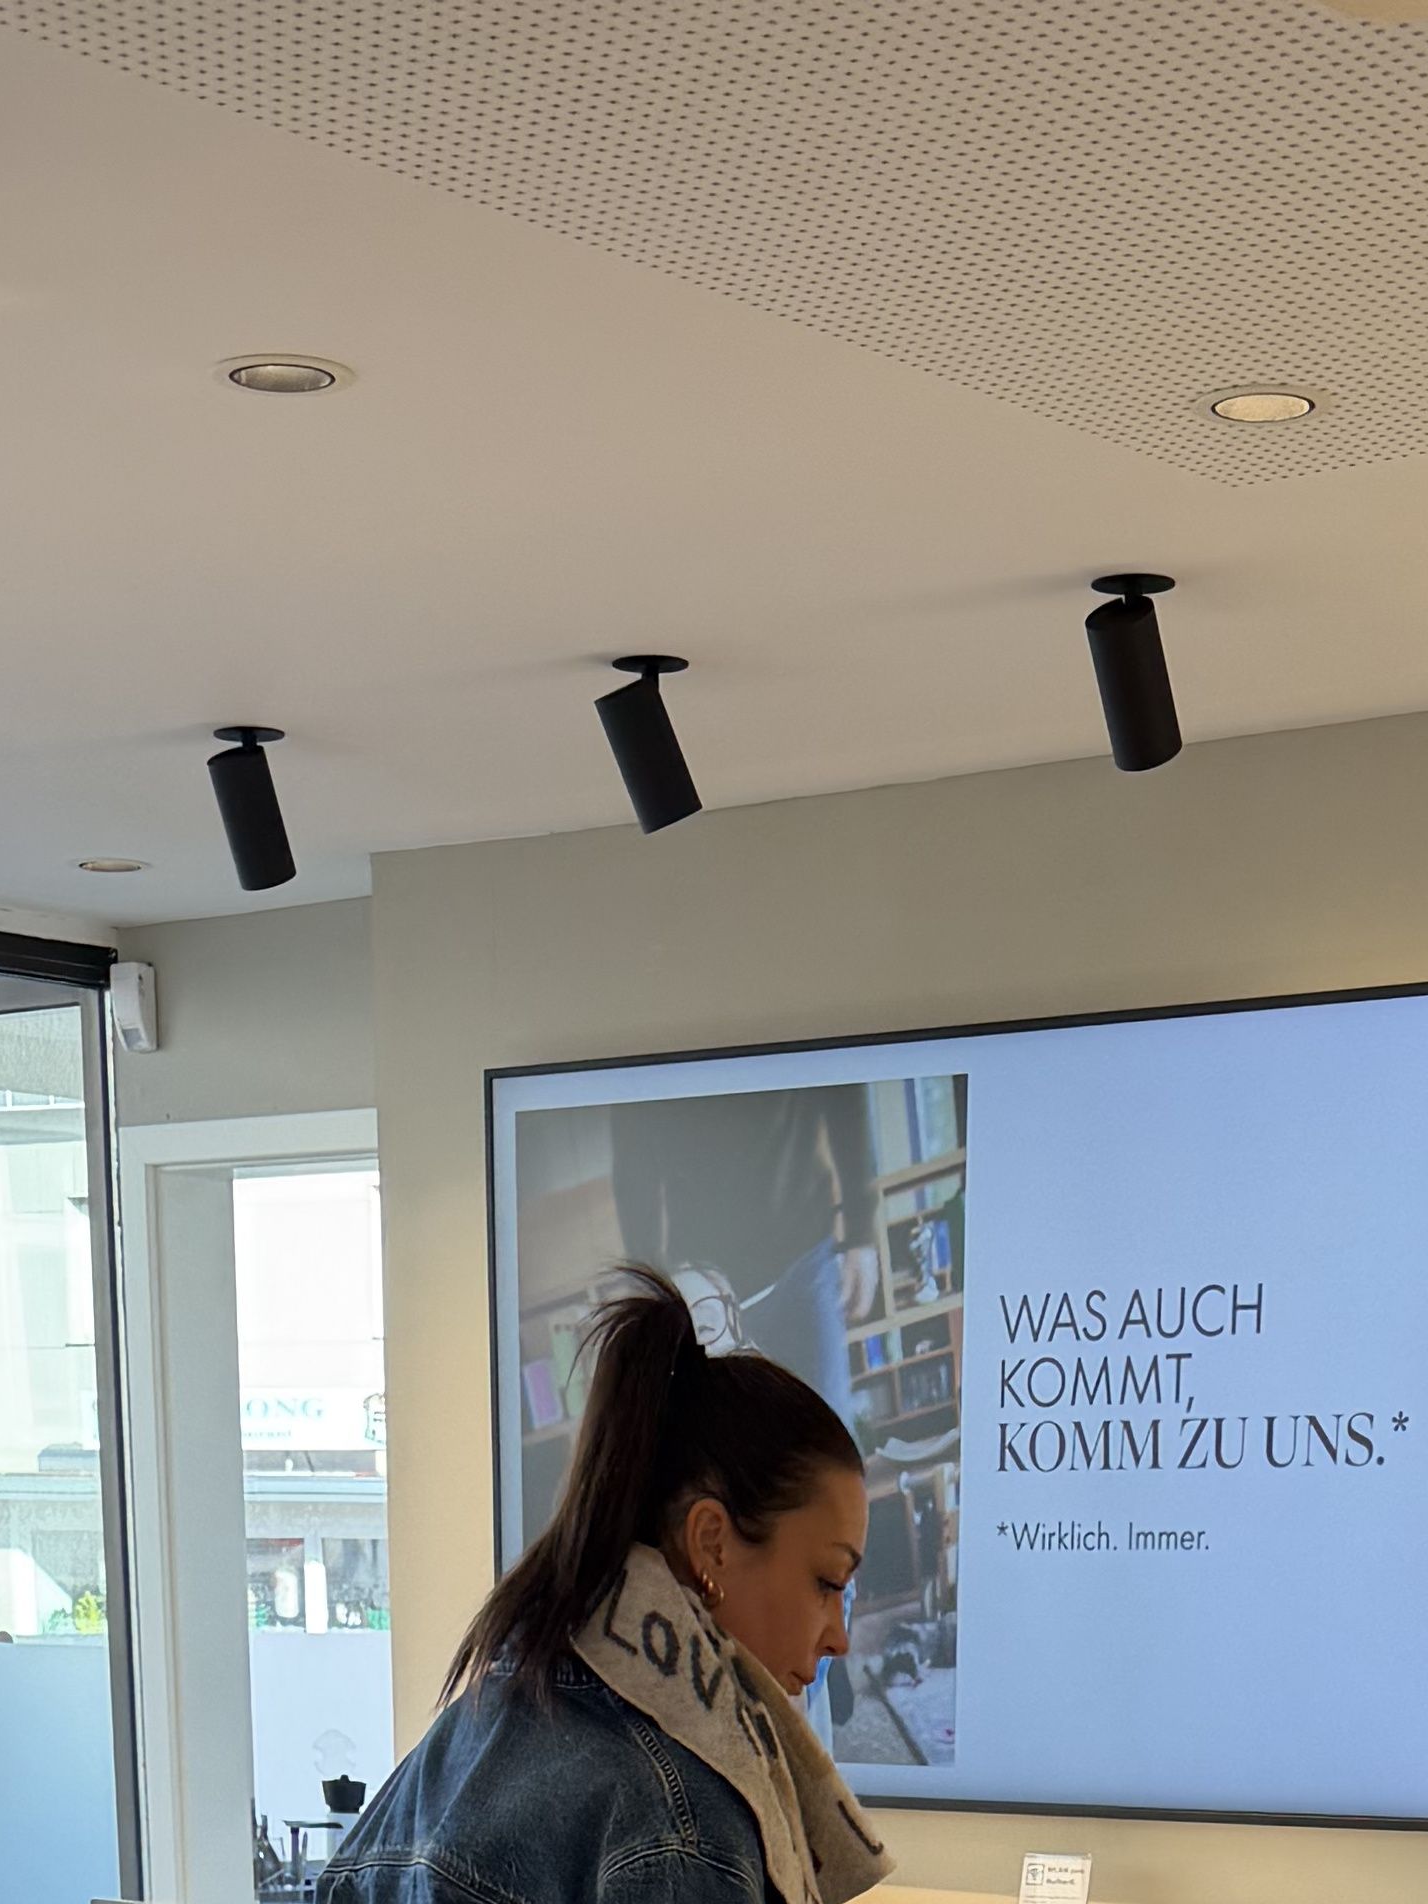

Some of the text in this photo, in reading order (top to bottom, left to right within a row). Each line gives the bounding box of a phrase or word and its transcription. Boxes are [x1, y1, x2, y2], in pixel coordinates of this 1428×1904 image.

[999, 1283, 1264, 1344] WAS AUCH
[999, 1352, 1196, 1413] KOMMT,
[996, 1418, 1164, 1473] KOMM
[1177, 1416, 1249, 1469] ZU
[1128, 1521, 1211, 1551] Immer.
